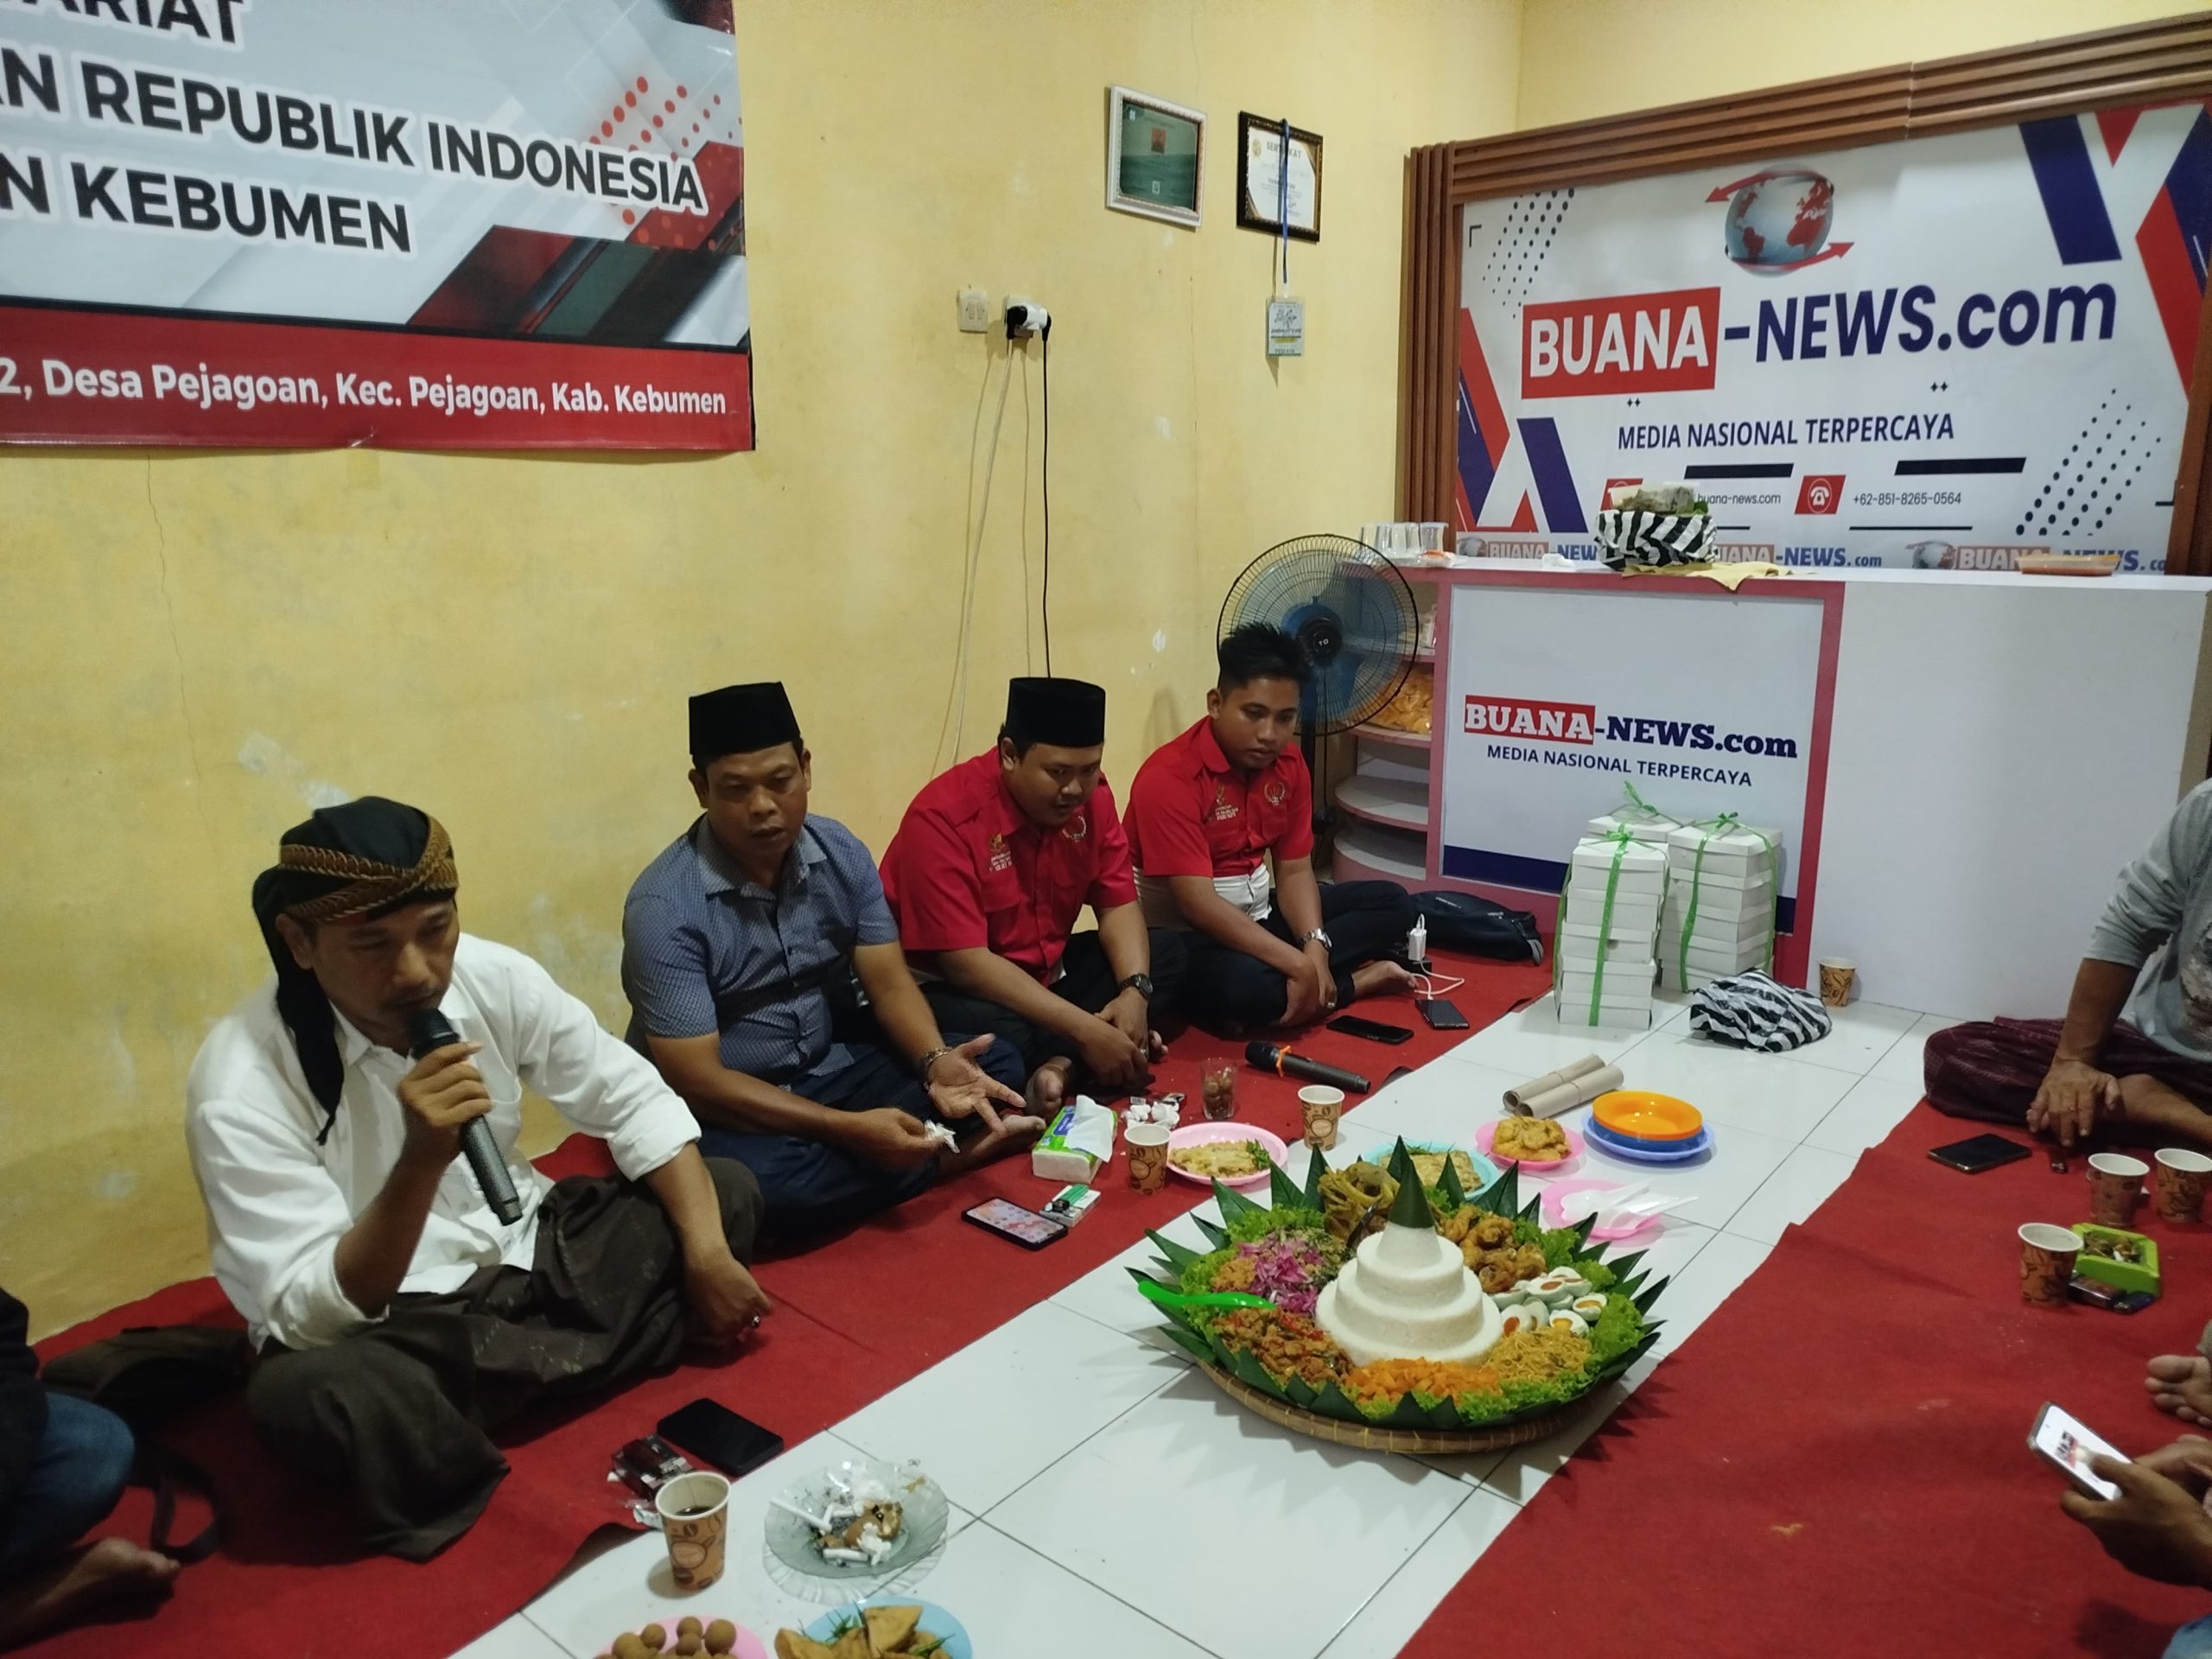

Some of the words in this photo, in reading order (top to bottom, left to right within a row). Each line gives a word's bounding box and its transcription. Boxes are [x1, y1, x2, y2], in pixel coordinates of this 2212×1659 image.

[81, 60, 415, 167] REPUBLIK
[428, 122, 703, 209] INDONESIA
[70, 162, 410, 252] KEBUMEN
[42, 359, 143, 398] Desa
[152, 362, 328, 410] Pejagoan,
[336, 373, 402, 406] Kec.
[409, 374, 545, 416] Pejagoan,
[551, 382, 609, 412] Kab.
[614, 384, 726, 414] Kebumen
[1618, 424, 1681, 449] MEDIA
[1688, 420, 1797, 448] NASIONAL
[1806, 413, 1954, 444] TERPERCAYA
[1853, 492, 1961, 505] +62-851-8265-0564
[1487, 745, 1539, 763] MEDIA
[1543, 751, 1631, 773] NASIONAL
[1637, 760, 1752, 786] TERPERCAYA
